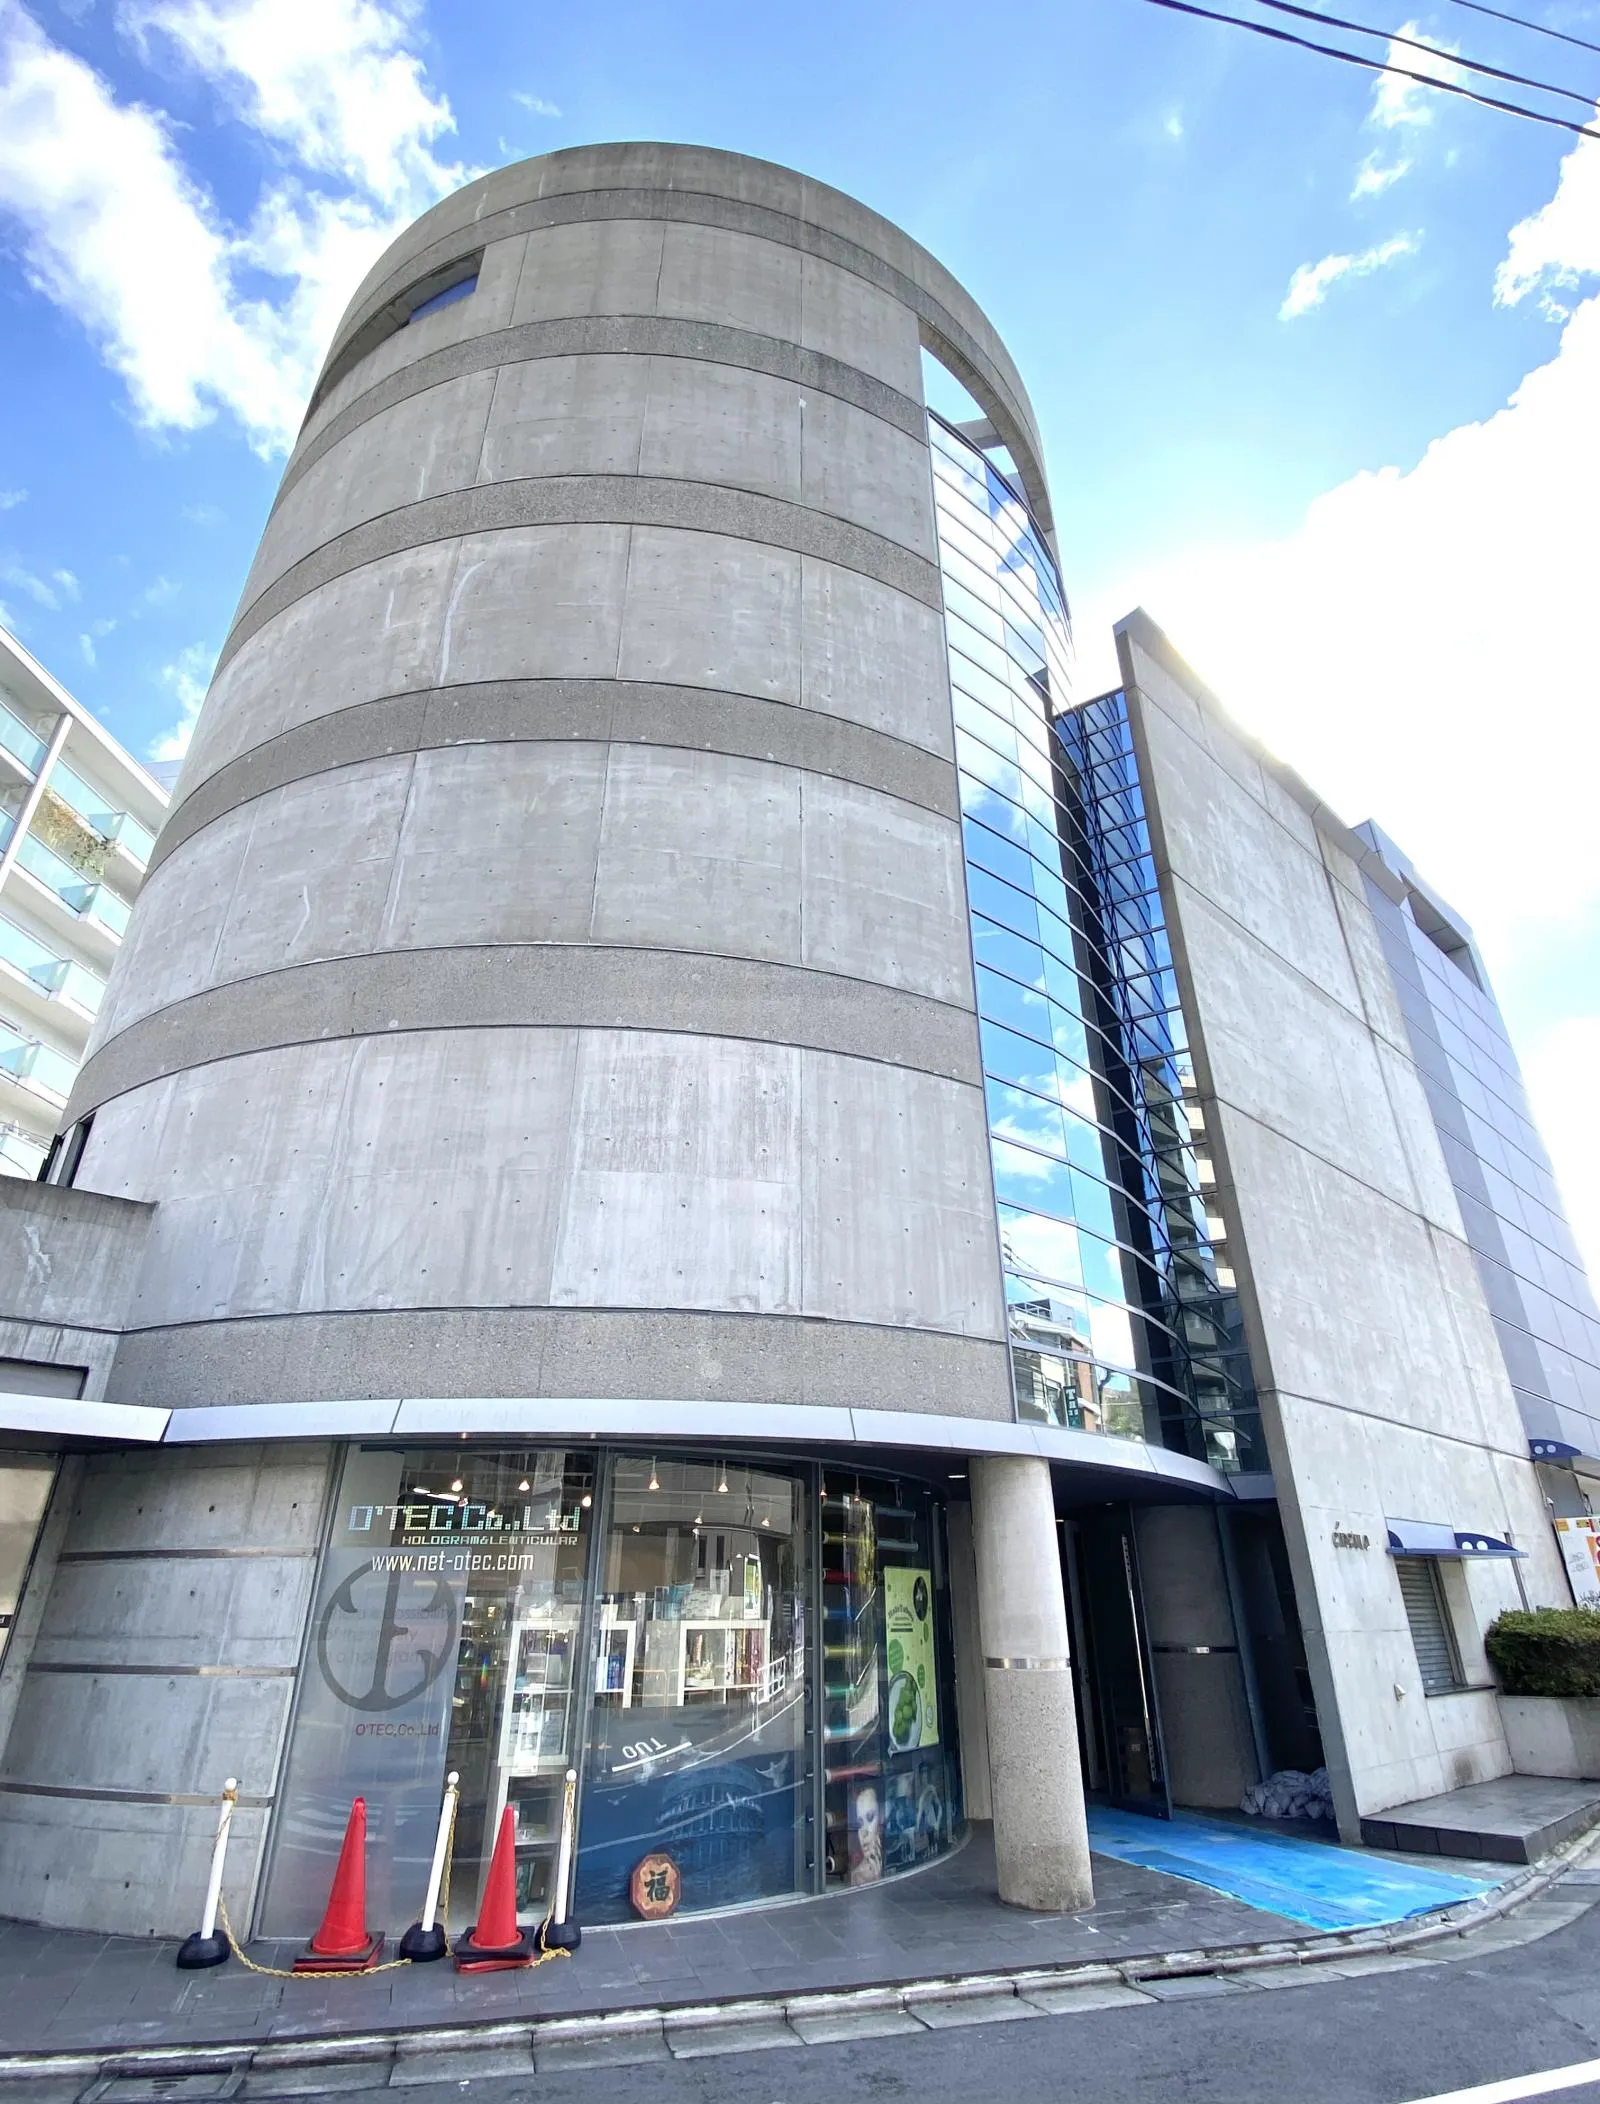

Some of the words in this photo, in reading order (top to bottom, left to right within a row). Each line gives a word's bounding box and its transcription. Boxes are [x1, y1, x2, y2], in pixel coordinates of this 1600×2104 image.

[348, 1505, 454, 1531] O'TEC
[401, 1535, 579, 1546] HOLOGRAM&LENTICULAR
[372, 1551, 534, 1571] www.net-otec.com
[644, 1867, 670, 1902] 福
